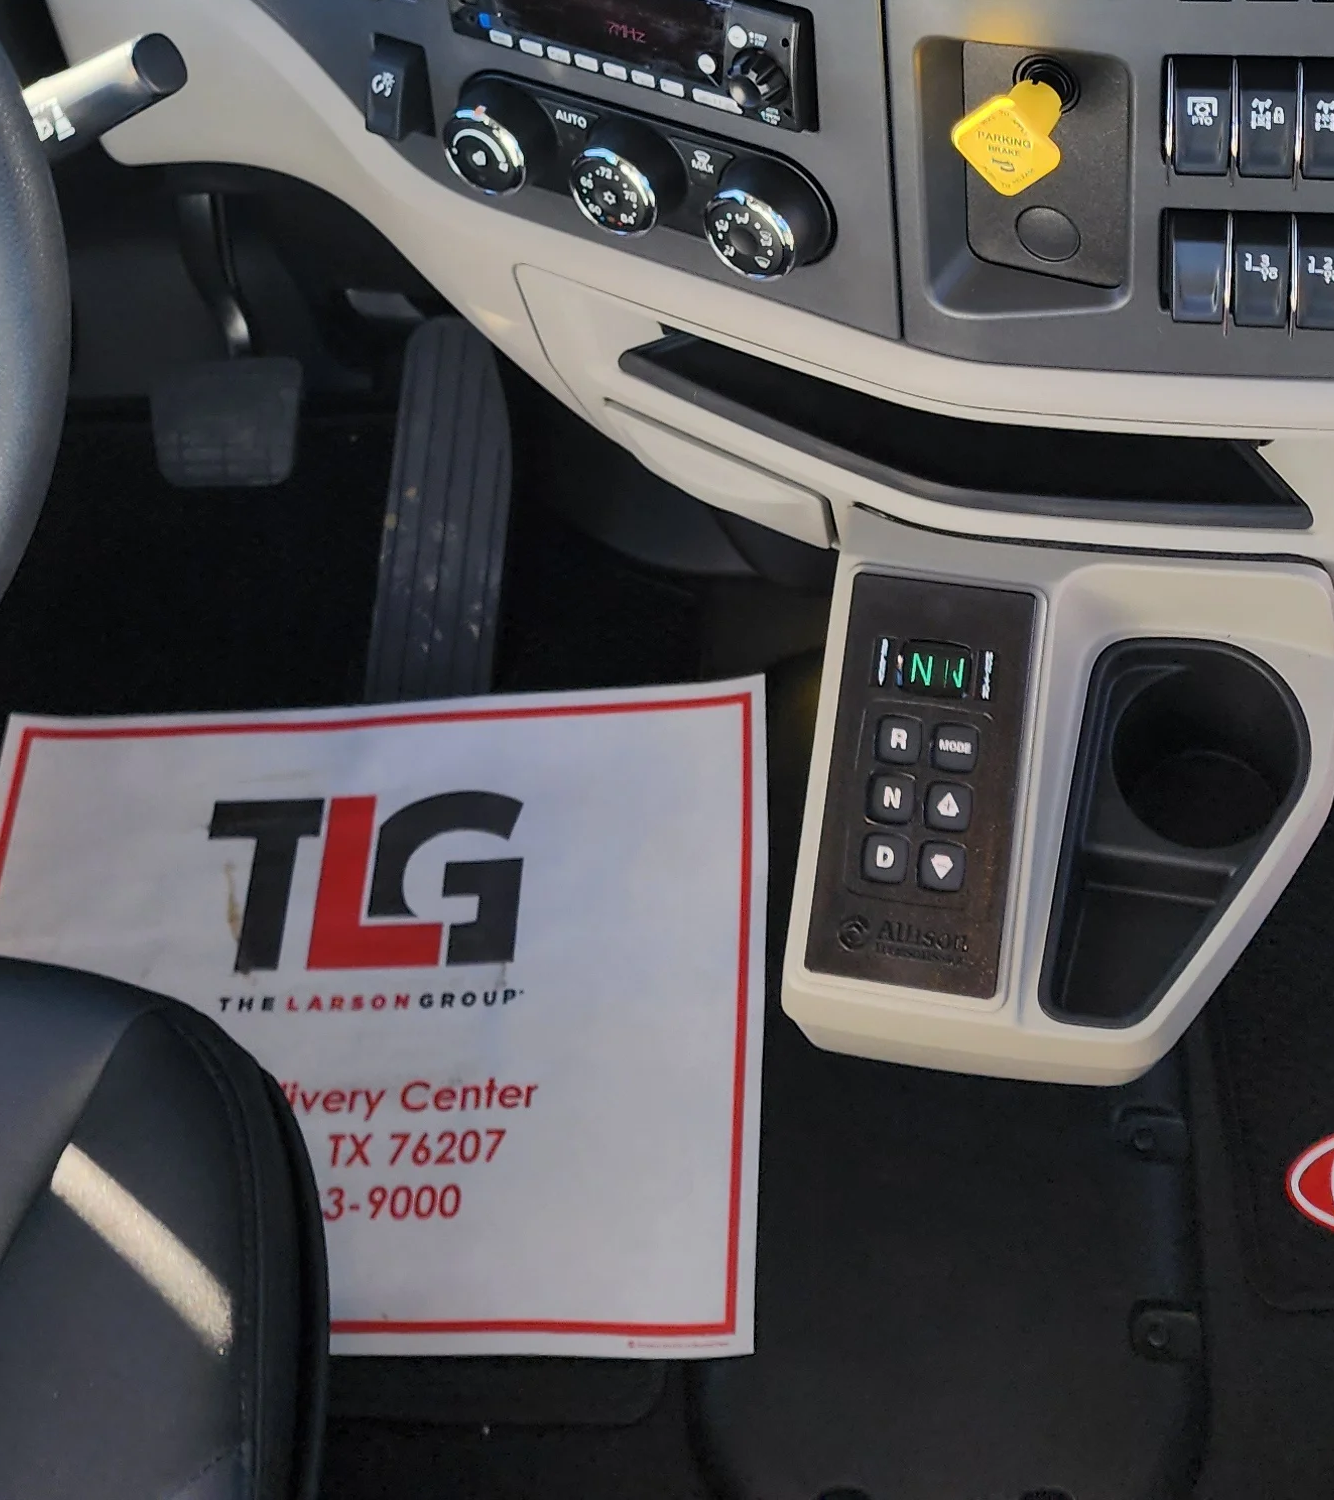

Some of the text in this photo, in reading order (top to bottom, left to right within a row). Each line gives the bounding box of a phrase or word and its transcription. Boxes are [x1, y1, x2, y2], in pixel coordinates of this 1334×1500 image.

[555, 108, 588, 130] AUTO
[1191, 114, 1213, 126] PTO
[978, 129, 1032, 149] PARKING
[987, 143, 1021, 158] BRAKE
[691, 158, 716, 175] MAX
[911, 652, 934, 687] N
[890, 727, 908, 750] R
[938, 738, 972, 755] MODE
[883, 785, 902, 810] N
[876, 845, 895, 869] D
[208, 790, 525, 972] TLG
[877, 919, 970, 952] Allison
[219, 988, 518, 1013] THE LARSON GROUP
[400, 1077, 539, 1113] Center
[329, 1128, 506, 1168] TX 76207
